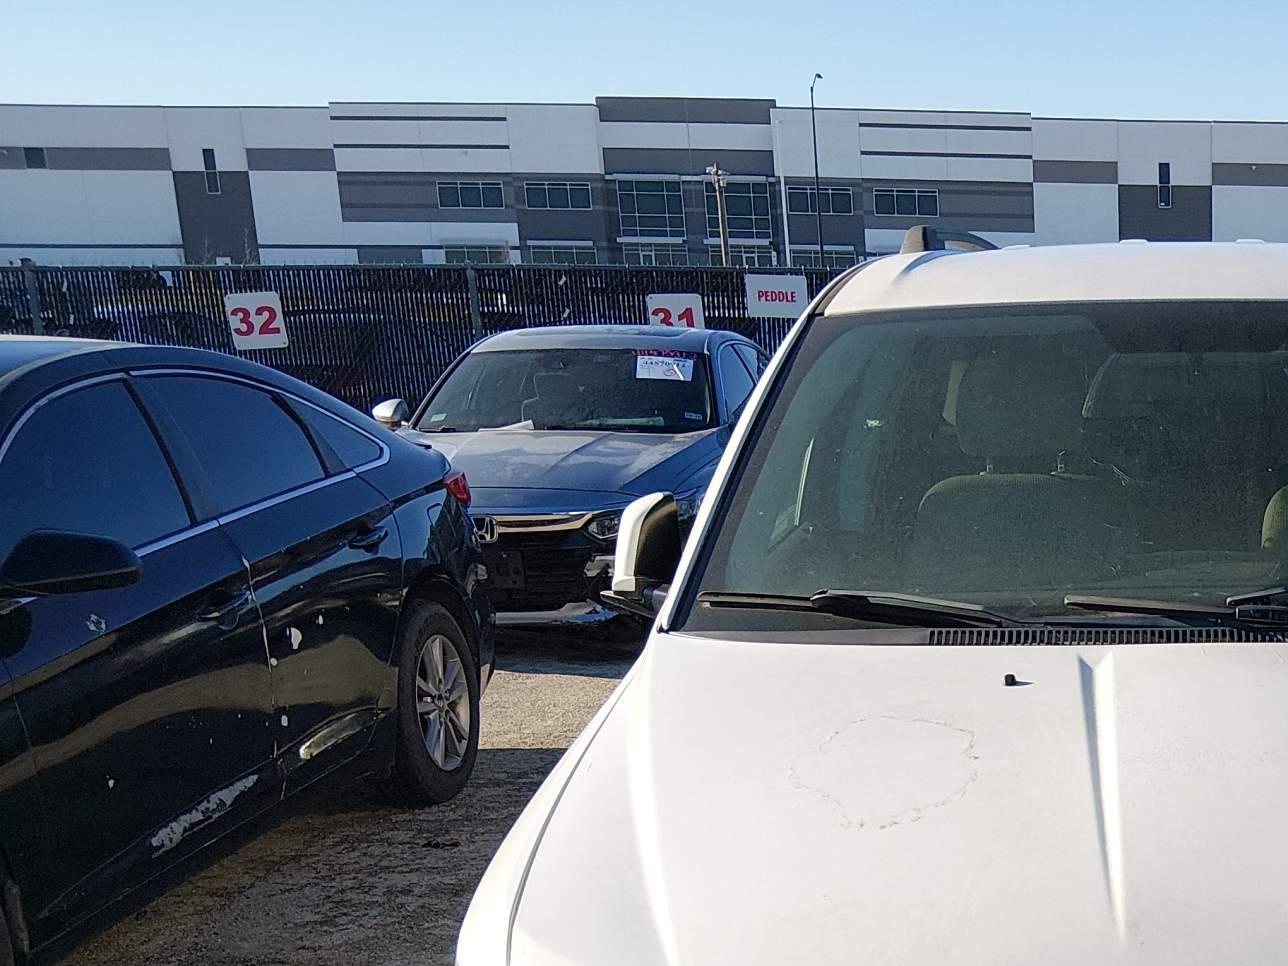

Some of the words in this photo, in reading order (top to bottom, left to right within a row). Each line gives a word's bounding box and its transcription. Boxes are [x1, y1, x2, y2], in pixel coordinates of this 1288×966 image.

[757, 290, 797, 303] PEDDLE
[230, 305, 281, 337] 32
[651, 306, 695, 328] 31
